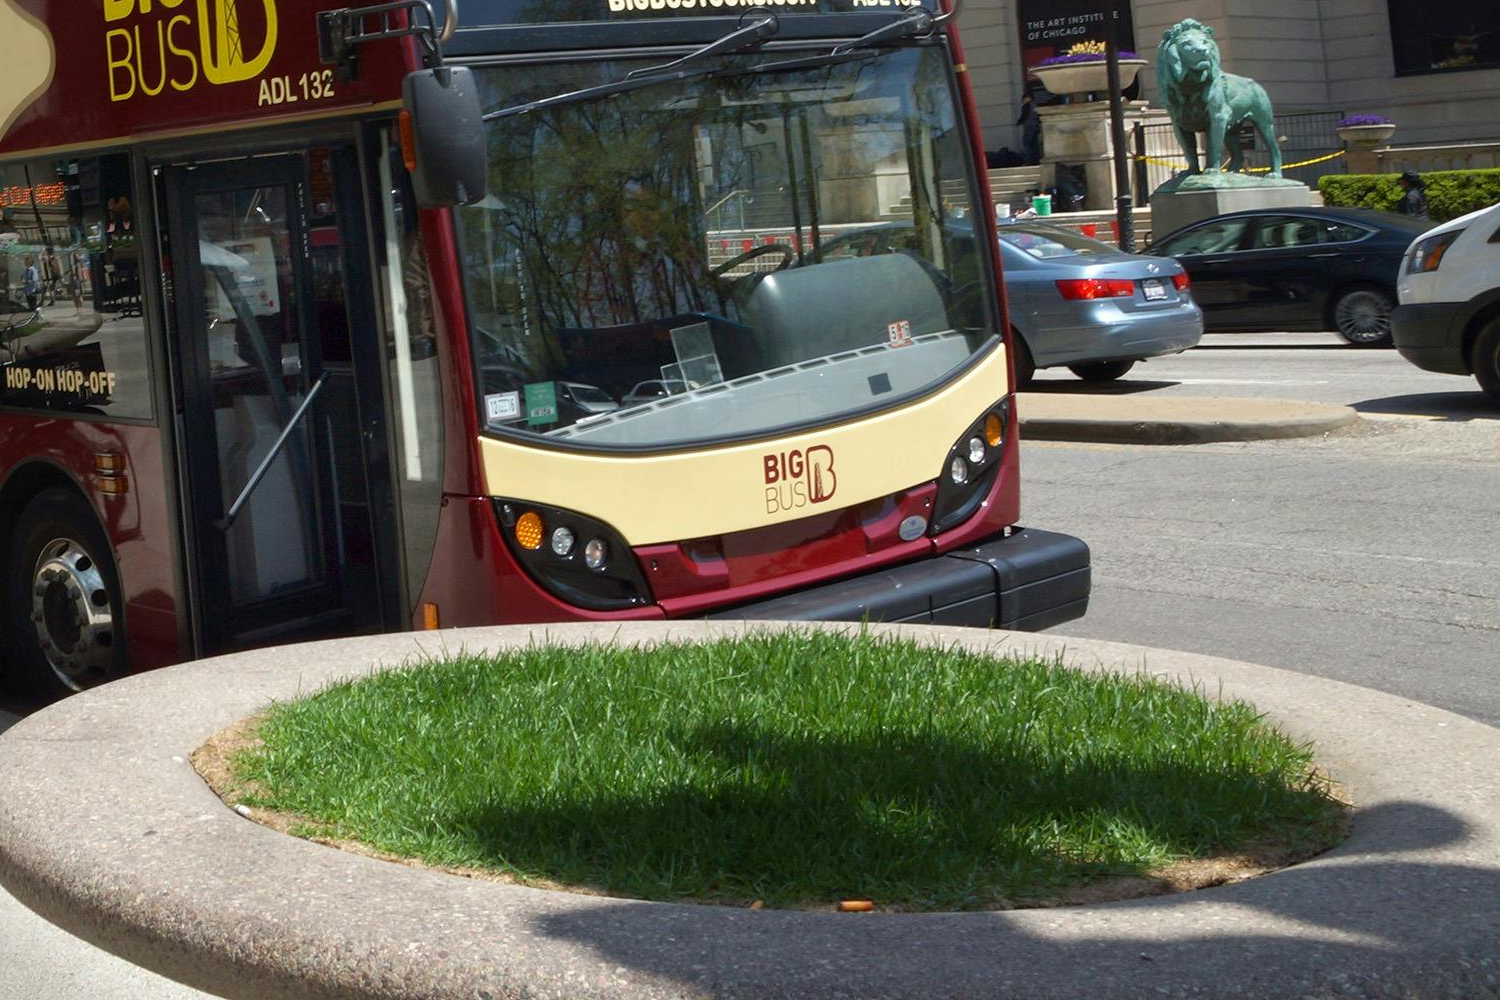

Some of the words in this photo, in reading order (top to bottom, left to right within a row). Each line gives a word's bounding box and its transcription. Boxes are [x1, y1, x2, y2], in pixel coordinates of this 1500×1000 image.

[1026, 20, 1045, 30] THE
[1047, 18, 1066, 28] ART
[1068, 10, 1119, 25] INSTITE
[1027, 32, 1040, 41] OF
[1042, 26, 1087, 39] CHICAGO
[106, 14, 198, 102] BUS
[258, 76, 298, 106] ADL
[299, 69, 335, 100] 132
[5, 367, 55, 391] HOP-ON
[56, 369, 116, 395] HOP-OFF
[763, 449, 804, 485] BIG
[765, 481, 807, 514] BUS
